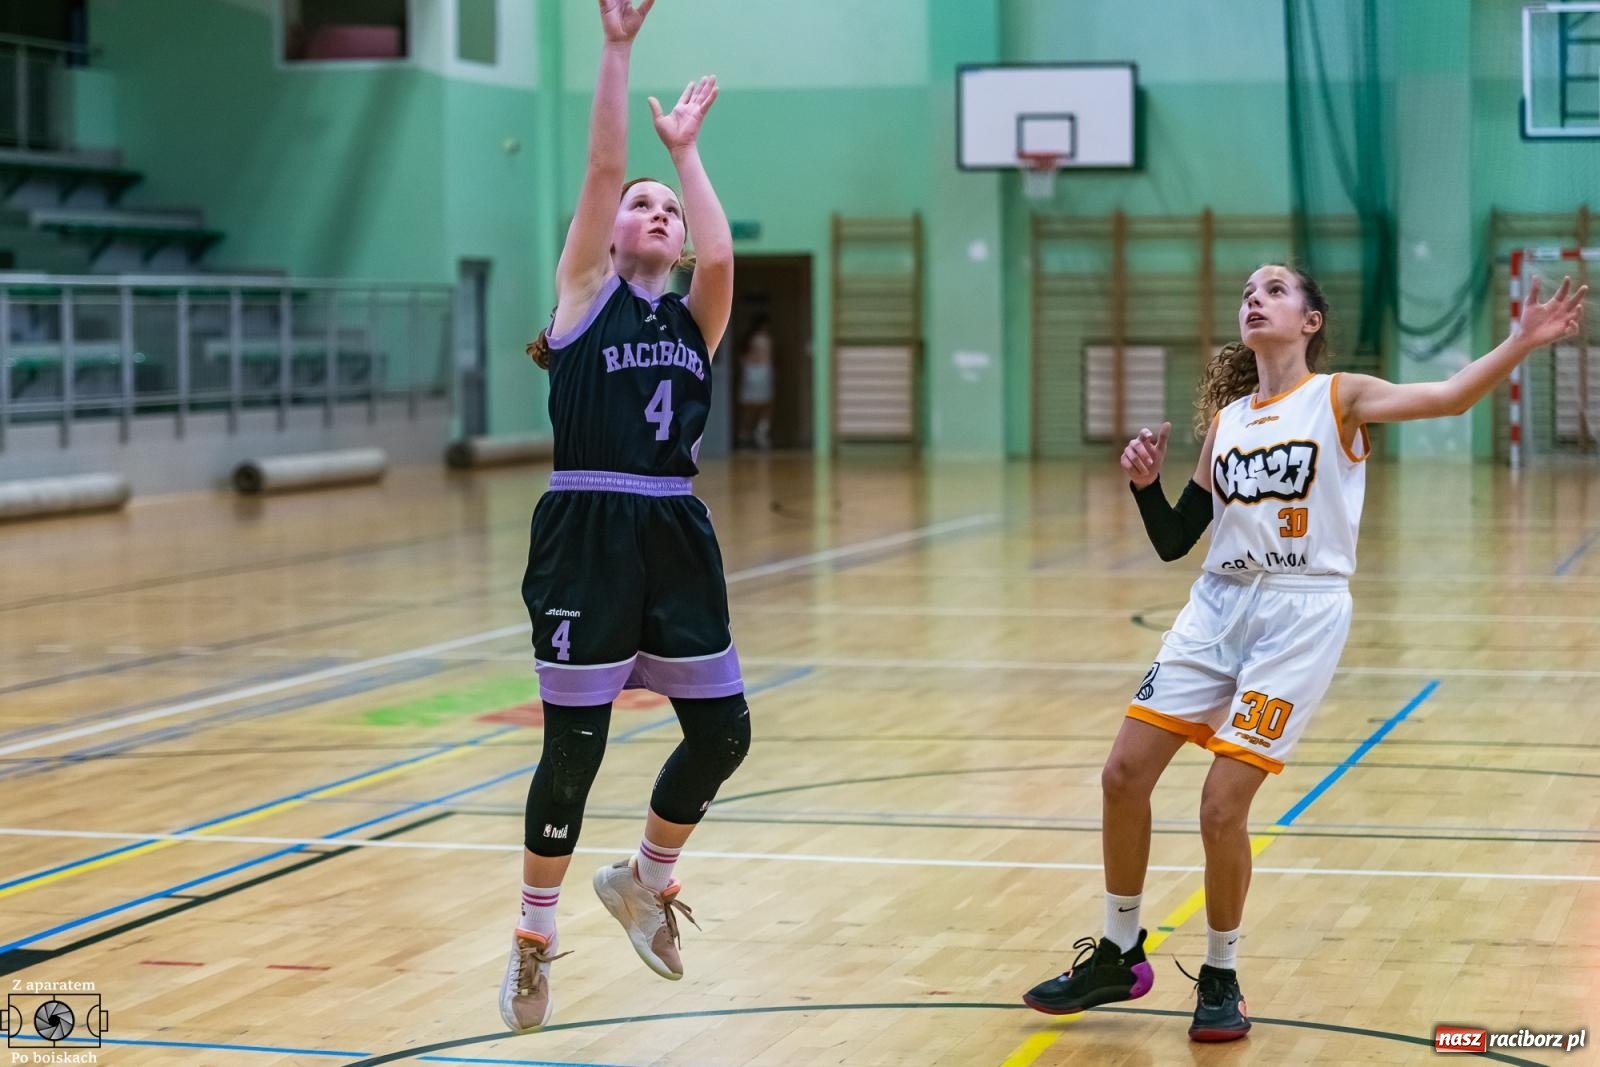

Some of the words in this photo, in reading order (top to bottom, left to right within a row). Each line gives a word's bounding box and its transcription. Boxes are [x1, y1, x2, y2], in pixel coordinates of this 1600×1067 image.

[644, 379, 674, 441] 4
[1278, 507, 1308, 538] 30
[551, 619, 571, 661] 4
[1232, 690, 1294, 740] 30
